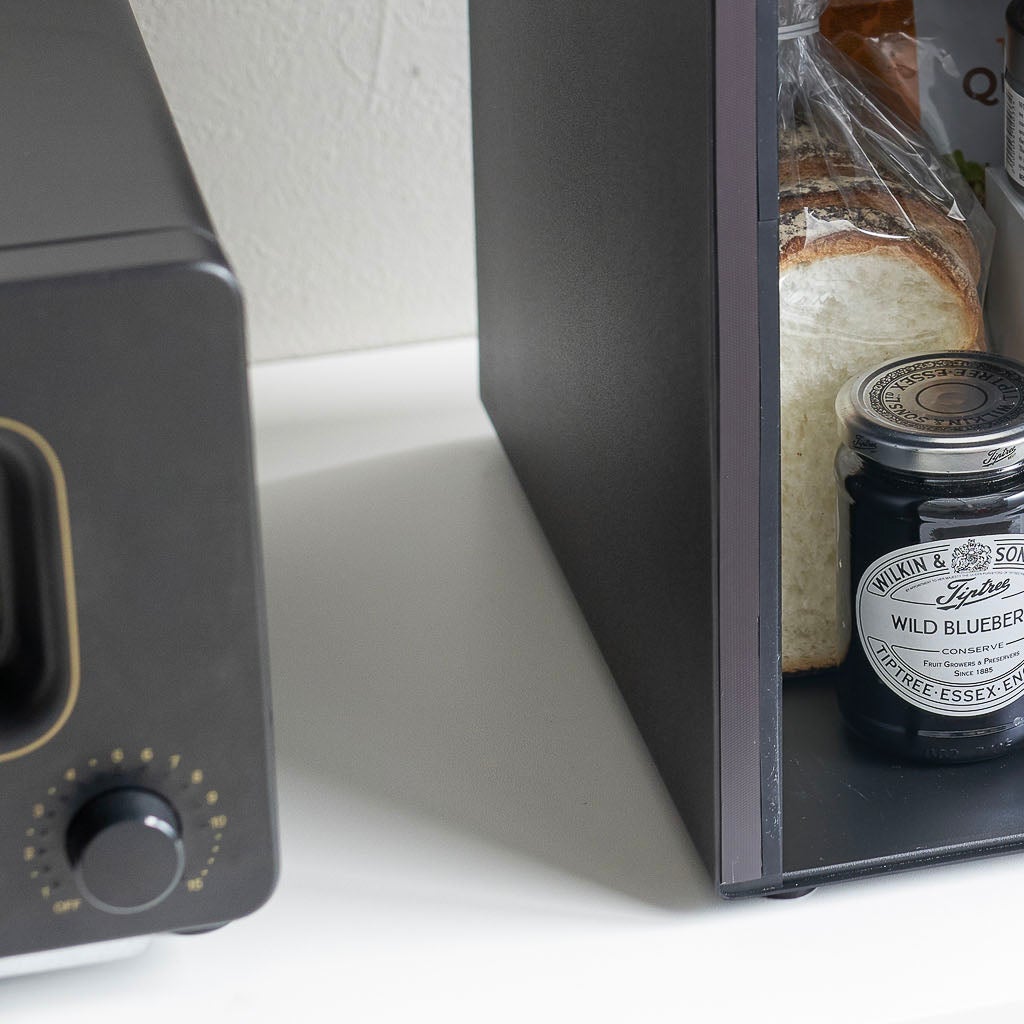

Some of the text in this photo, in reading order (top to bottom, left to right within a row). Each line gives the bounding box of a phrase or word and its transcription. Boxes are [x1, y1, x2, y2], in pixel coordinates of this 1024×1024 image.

[893, 368, 948, 392] ESSEX
[890, 403, 928, 424] SONS
[872, 559, 927, 593] WILKIN
[933, 554, 946, 568] &
[936, 577, 1010, 610] Tiptree
[891, 614, 938, 635] WILD
[941, 641, 1004, 655] CONSERVE
[923, 660, 942, 668] FRUIT
[943, 659, 975, 668] GROWERS
[983, 651, 1020, 665] PRESERVERS
[876, 644, 934, 697] TIPTREE
[940, 684, 998, 702] ESSEX
[954, 666, 993, 677] SINCE 1885
